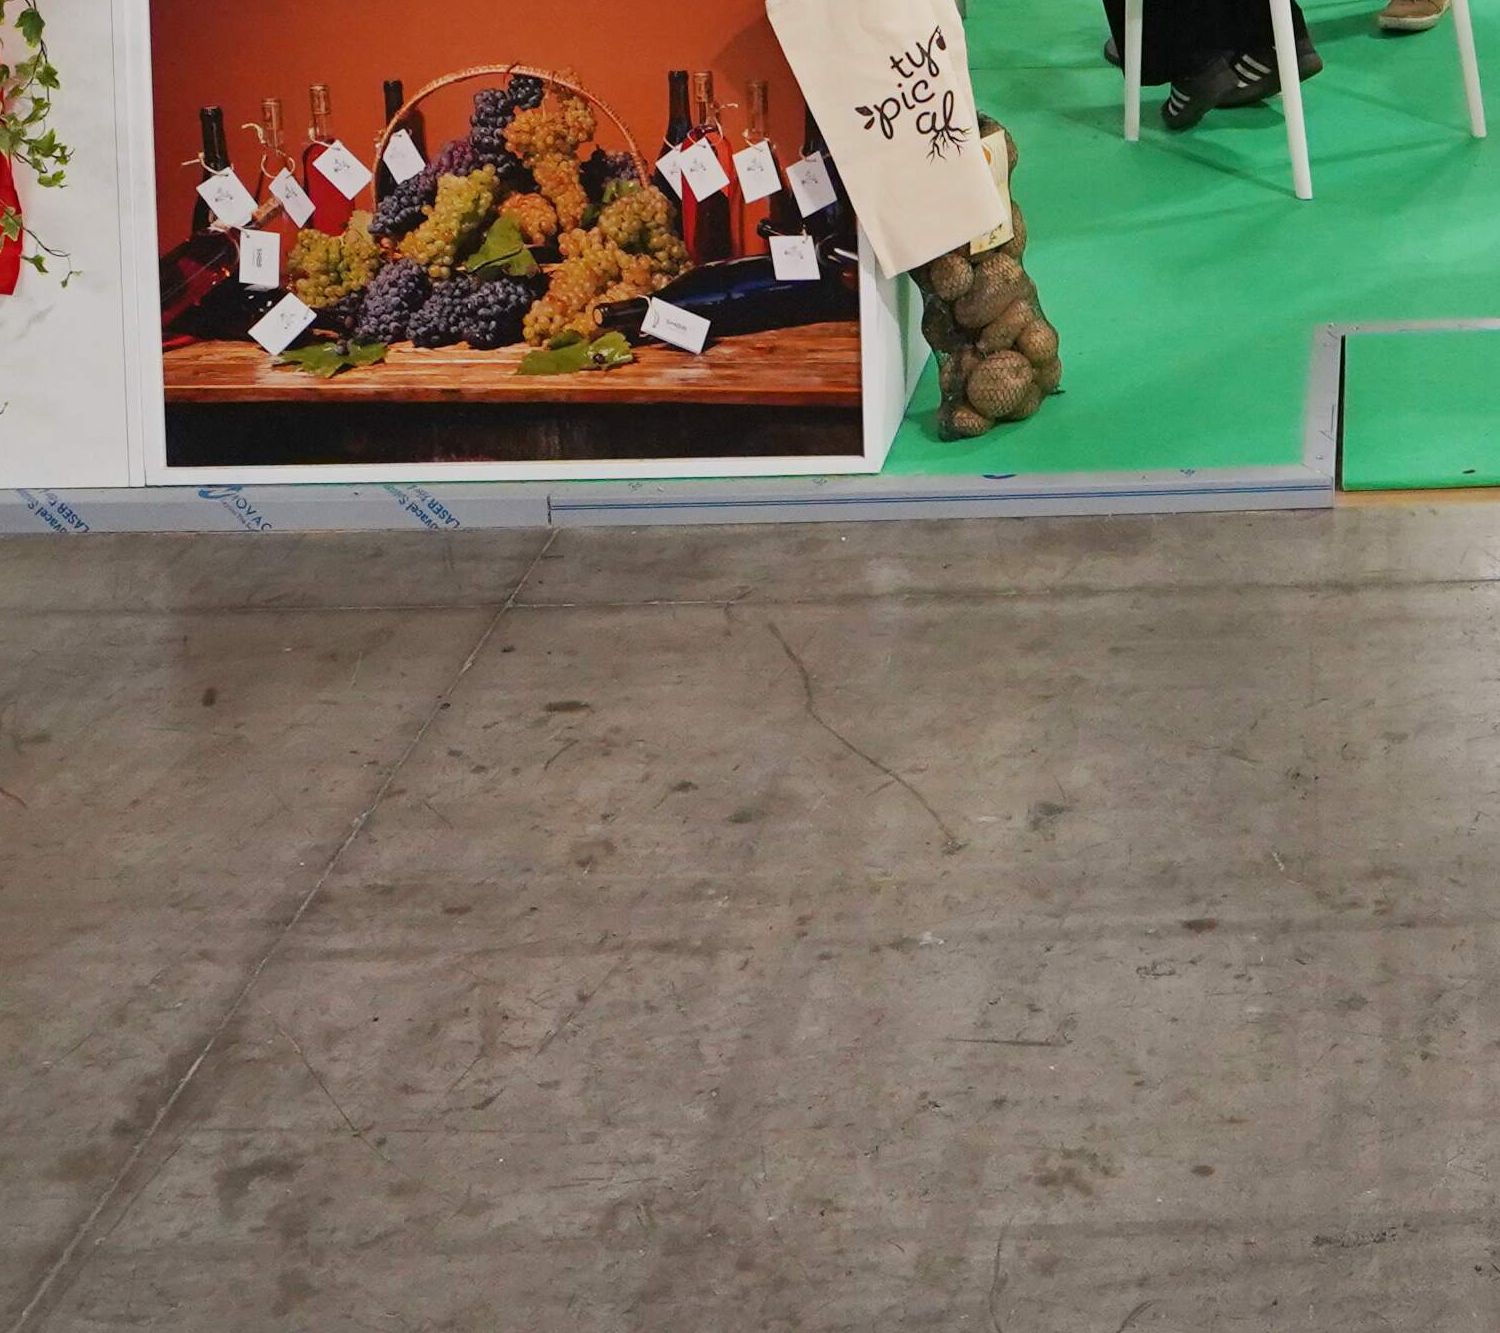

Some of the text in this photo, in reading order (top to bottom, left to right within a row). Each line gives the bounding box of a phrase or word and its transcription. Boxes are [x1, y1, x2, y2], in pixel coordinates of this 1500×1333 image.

[889, 25, 946, 79] ty
[873, 79, 936, 140] pic
[915, 89, 958, 135] al
[427, 498, 460, 529] LASER
